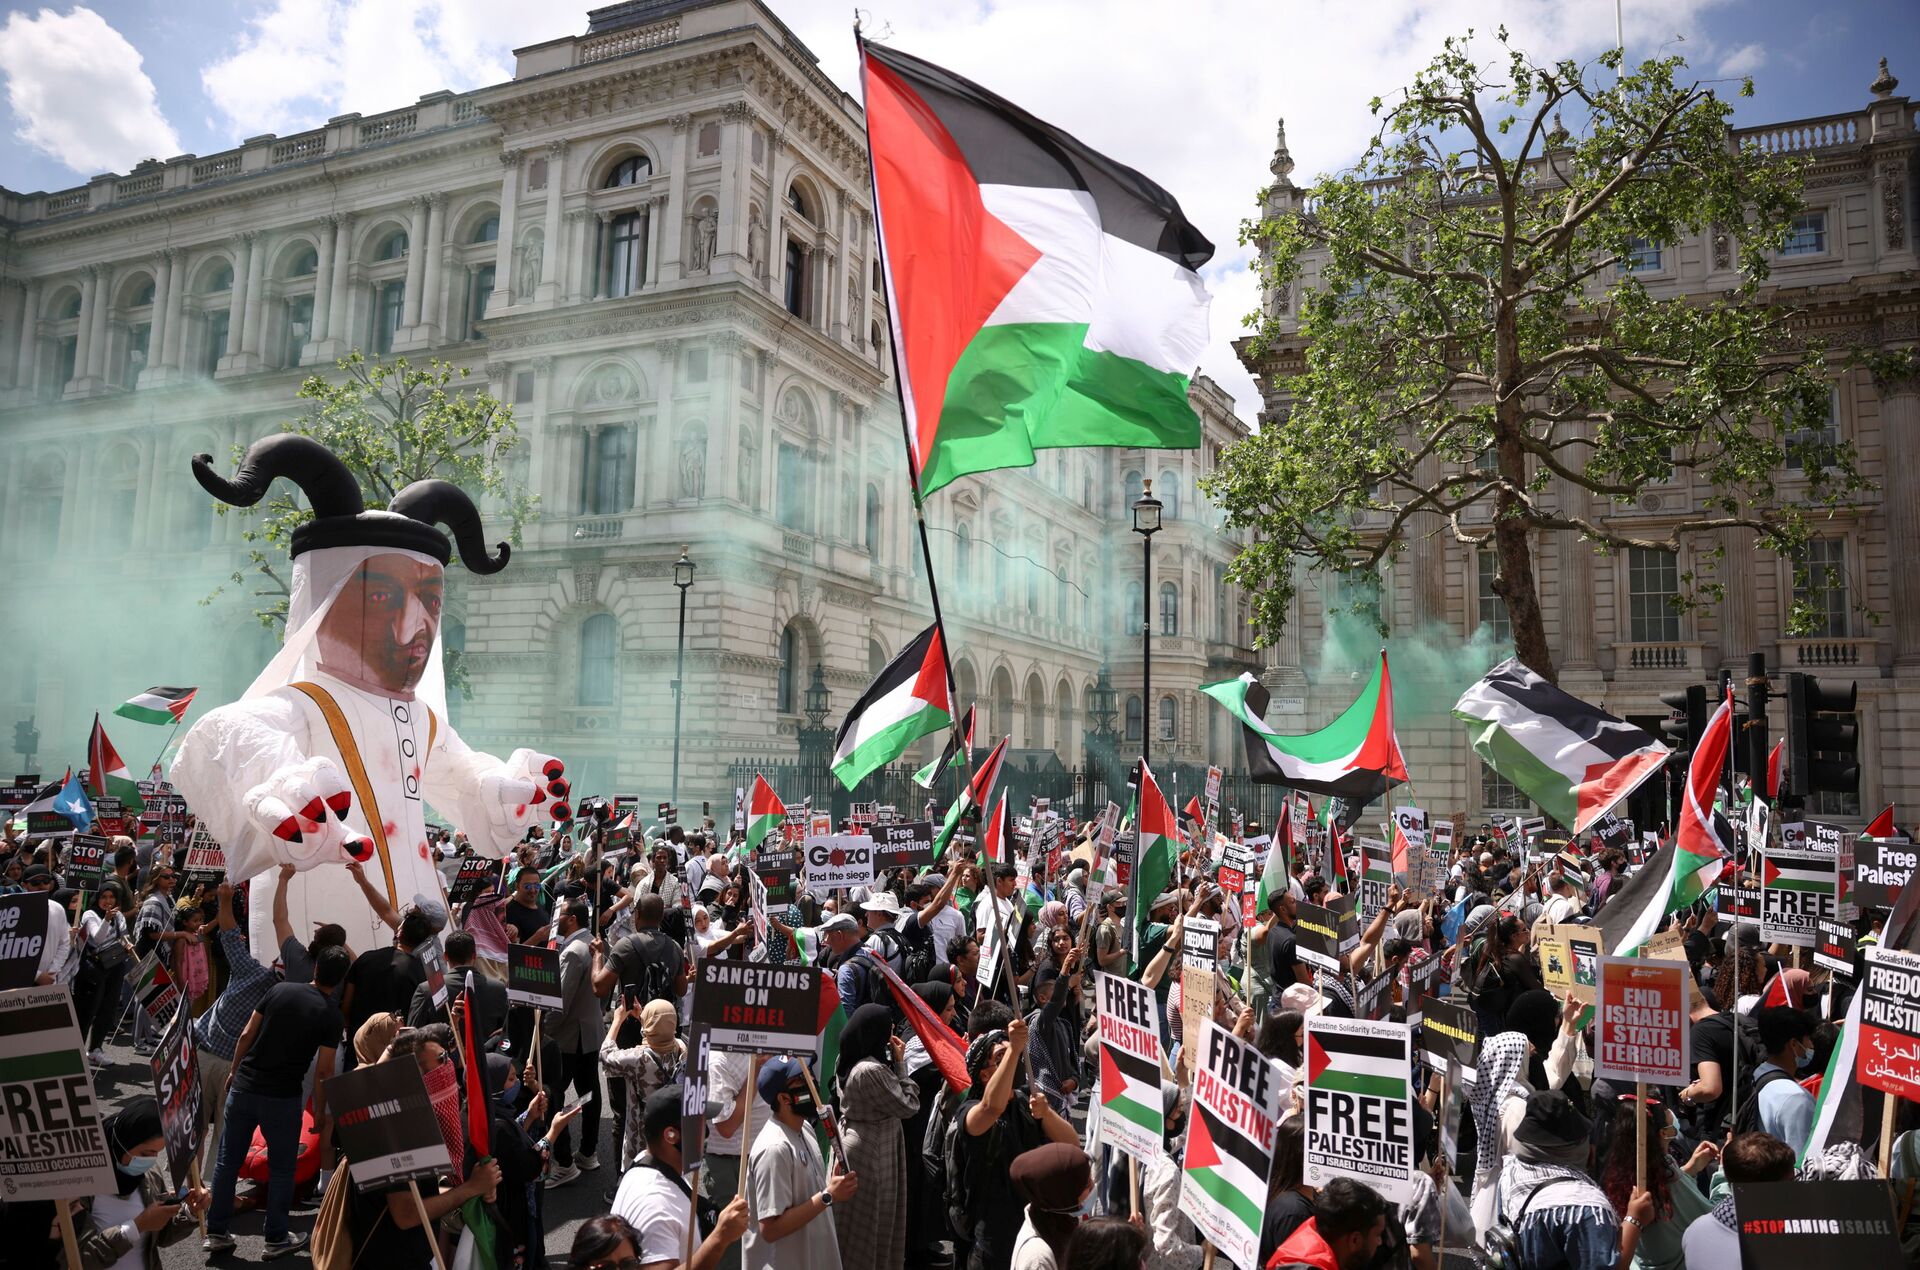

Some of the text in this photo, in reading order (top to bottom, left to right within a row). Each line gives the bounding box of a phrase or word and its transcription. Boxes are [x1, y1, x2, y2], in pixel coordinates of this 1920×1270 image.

[146, 800, 162, 811] FREE
[887, 828, 914, 840] Free
[73, 846, 104, 858] STOP
[874, 840, 931, 854] Palestine
[1806, 836, 1839, 854] Palest
[462, 860, 492, 870] STOP
[760, 853, 793, 862] SANCTIONS
[772, 860, 781, 868] ON
[809, 846, 869, 866] Gza
[1878, 846, 1917, 868] Free
[809, 870, 870, 881] End the siege
[1858, 864, 1914, 887] Palest
[1764, 889, 1834, 918] FREE
[0, 906, 20, 930] ee
[1764, 912, 1816, 927] PALESTI
[1819, 920, 1852, 939] SANCTIONS
[1829, 934, 1838, 945] ON
[0, 932, 42, 960] tine
[1185, 930, 1214, 951] FREEDOM
[525, 955, 543, 967] FREE
[1183, 954, 1214, 972] PALESTINE
[1412, 959, 1439, 982] SANCTIONS
[515, 967, 556, 984] PALESTINE
[706, 965, 810, 990] SANCTIONS
[1869, 966, 1920, 997] FREEDO
[28, 991, 66, 1007] Campaign
[745, 988, 769, 1006] ON
[1359, 973, 1391, 1008] SANCTIONS
[1624, 988, 1662, 1008] END
[1892, 993, 1905, 1005] for
[1105, 976, 1150, 1029] FREE
[723, 1005, 785, 1027] ISRAEL
[1605, 1005, 1679, 1029] ISRAELI
[1864, 998, 1920, 1034] PALESTI
[737, 1033, 749, 1042] FOA
[1100, 1015, 1158, 1061] PALESTINE
[1309, 1021, 1406, 1038] Palestine Solidarity Campaign
[1613, 1025, 1672, 1047] STATE
[161, 1019, 192, 1105] STOP
[1603, 1042, 1681, 1068] TERROR
[1209, 1028, 1270, 1110] FREE
[1602, 1063, 1682, 1077] socialistparty.org.uk
[0, 1075, 97, 1135] REE
[683, 1077, 706, 1117] Pale
[1196, 1068, 1273, 1151] PALESTINE
[1309, 1089, 1409, 1145] FREE
[1138, 1135, 1152, 1147] Britain
[1309, 1131, 1408, 1167] PALESTINE
[1, 1154, 105, 1174] END ISRAELI OCCUPATION
[1309, 1153, 1408, 1180] END ISRAELI OCCUPATION
[1744, 1220, 1890, 1235] #STOPARMINGISRAEL
